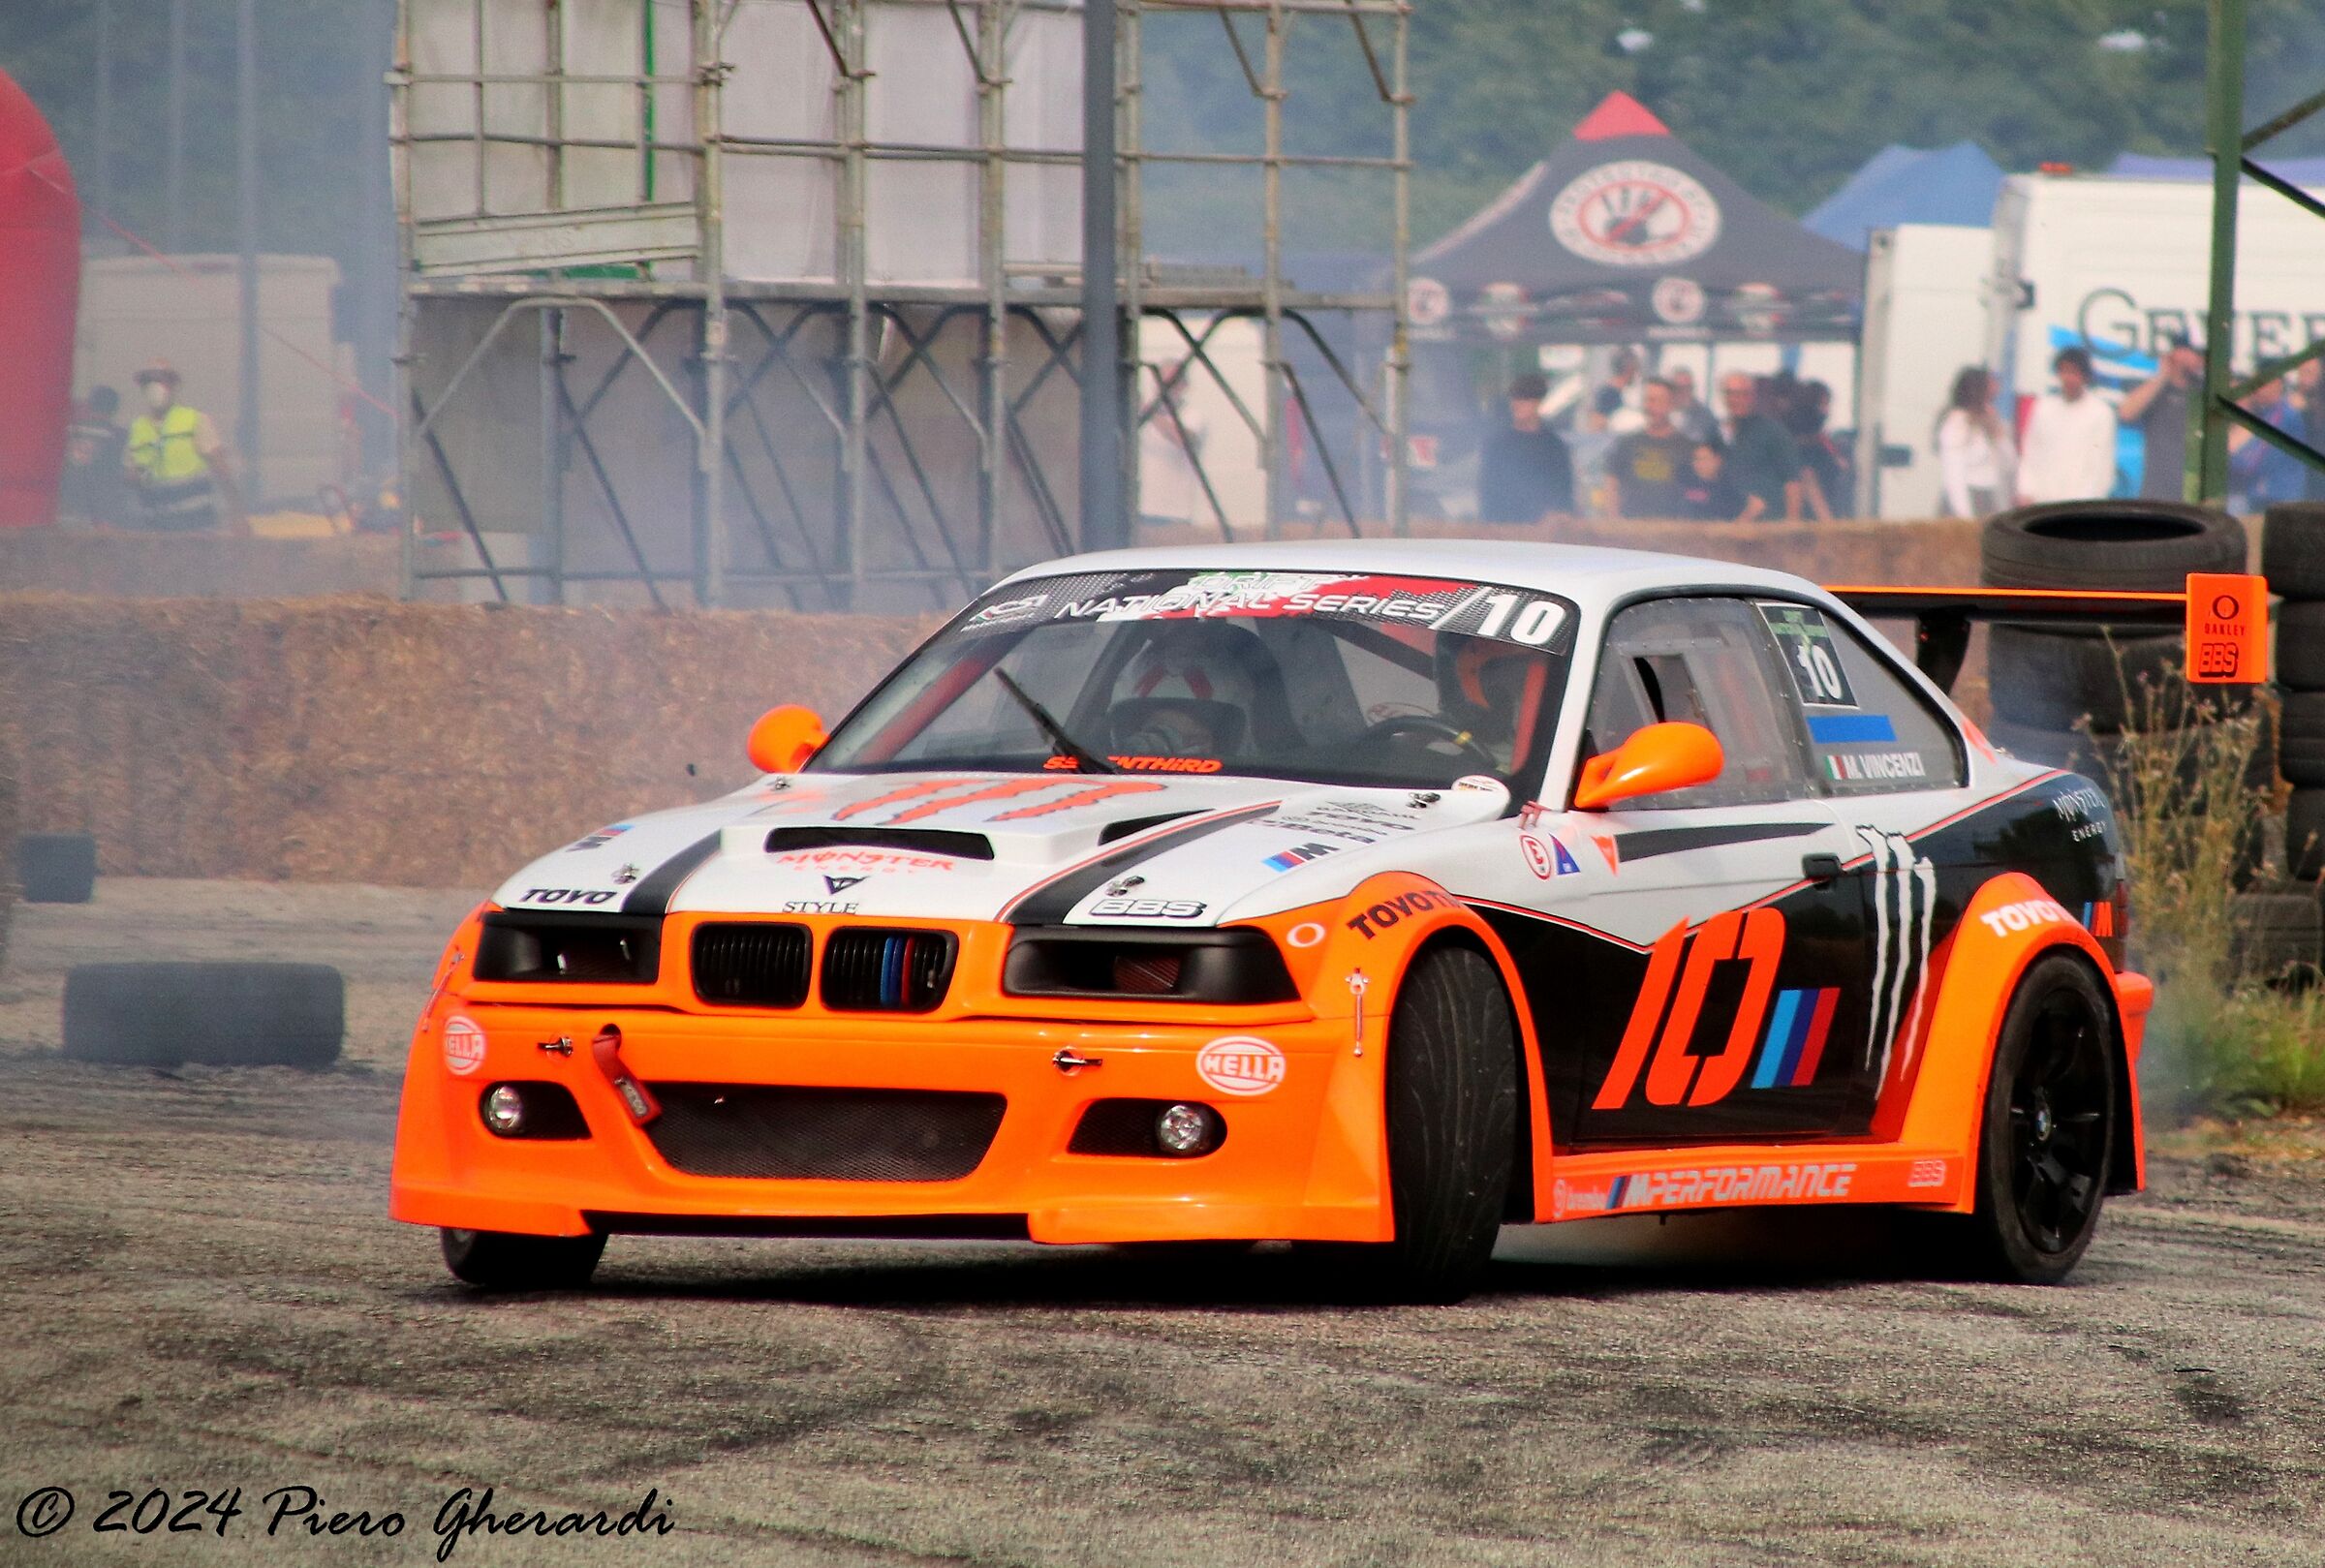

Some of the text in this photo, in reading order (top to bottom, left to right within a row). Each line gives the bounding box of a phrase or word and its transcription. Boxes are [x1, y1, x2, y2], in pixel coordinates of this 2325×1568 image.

[1054, 588, 1271, 620] NATIONAL
[1282, 592, 1447, 620] SERIES
[2204, 623, 2246, 636] OAKLEY
[1797, 644, 1842, 700] 10
[2198, 641, 2239, 678] BBS
[1859, 752, 1926, 778] VINCENZI
[519, 888, 618, 905] TOYO
[782, 901, 860, 915] STYLE
[1089, 899, 1208, 919] BBS
[1592, 907, 1786, 1110] 10
[1201, 1053, 1286, 1084] HELLA
